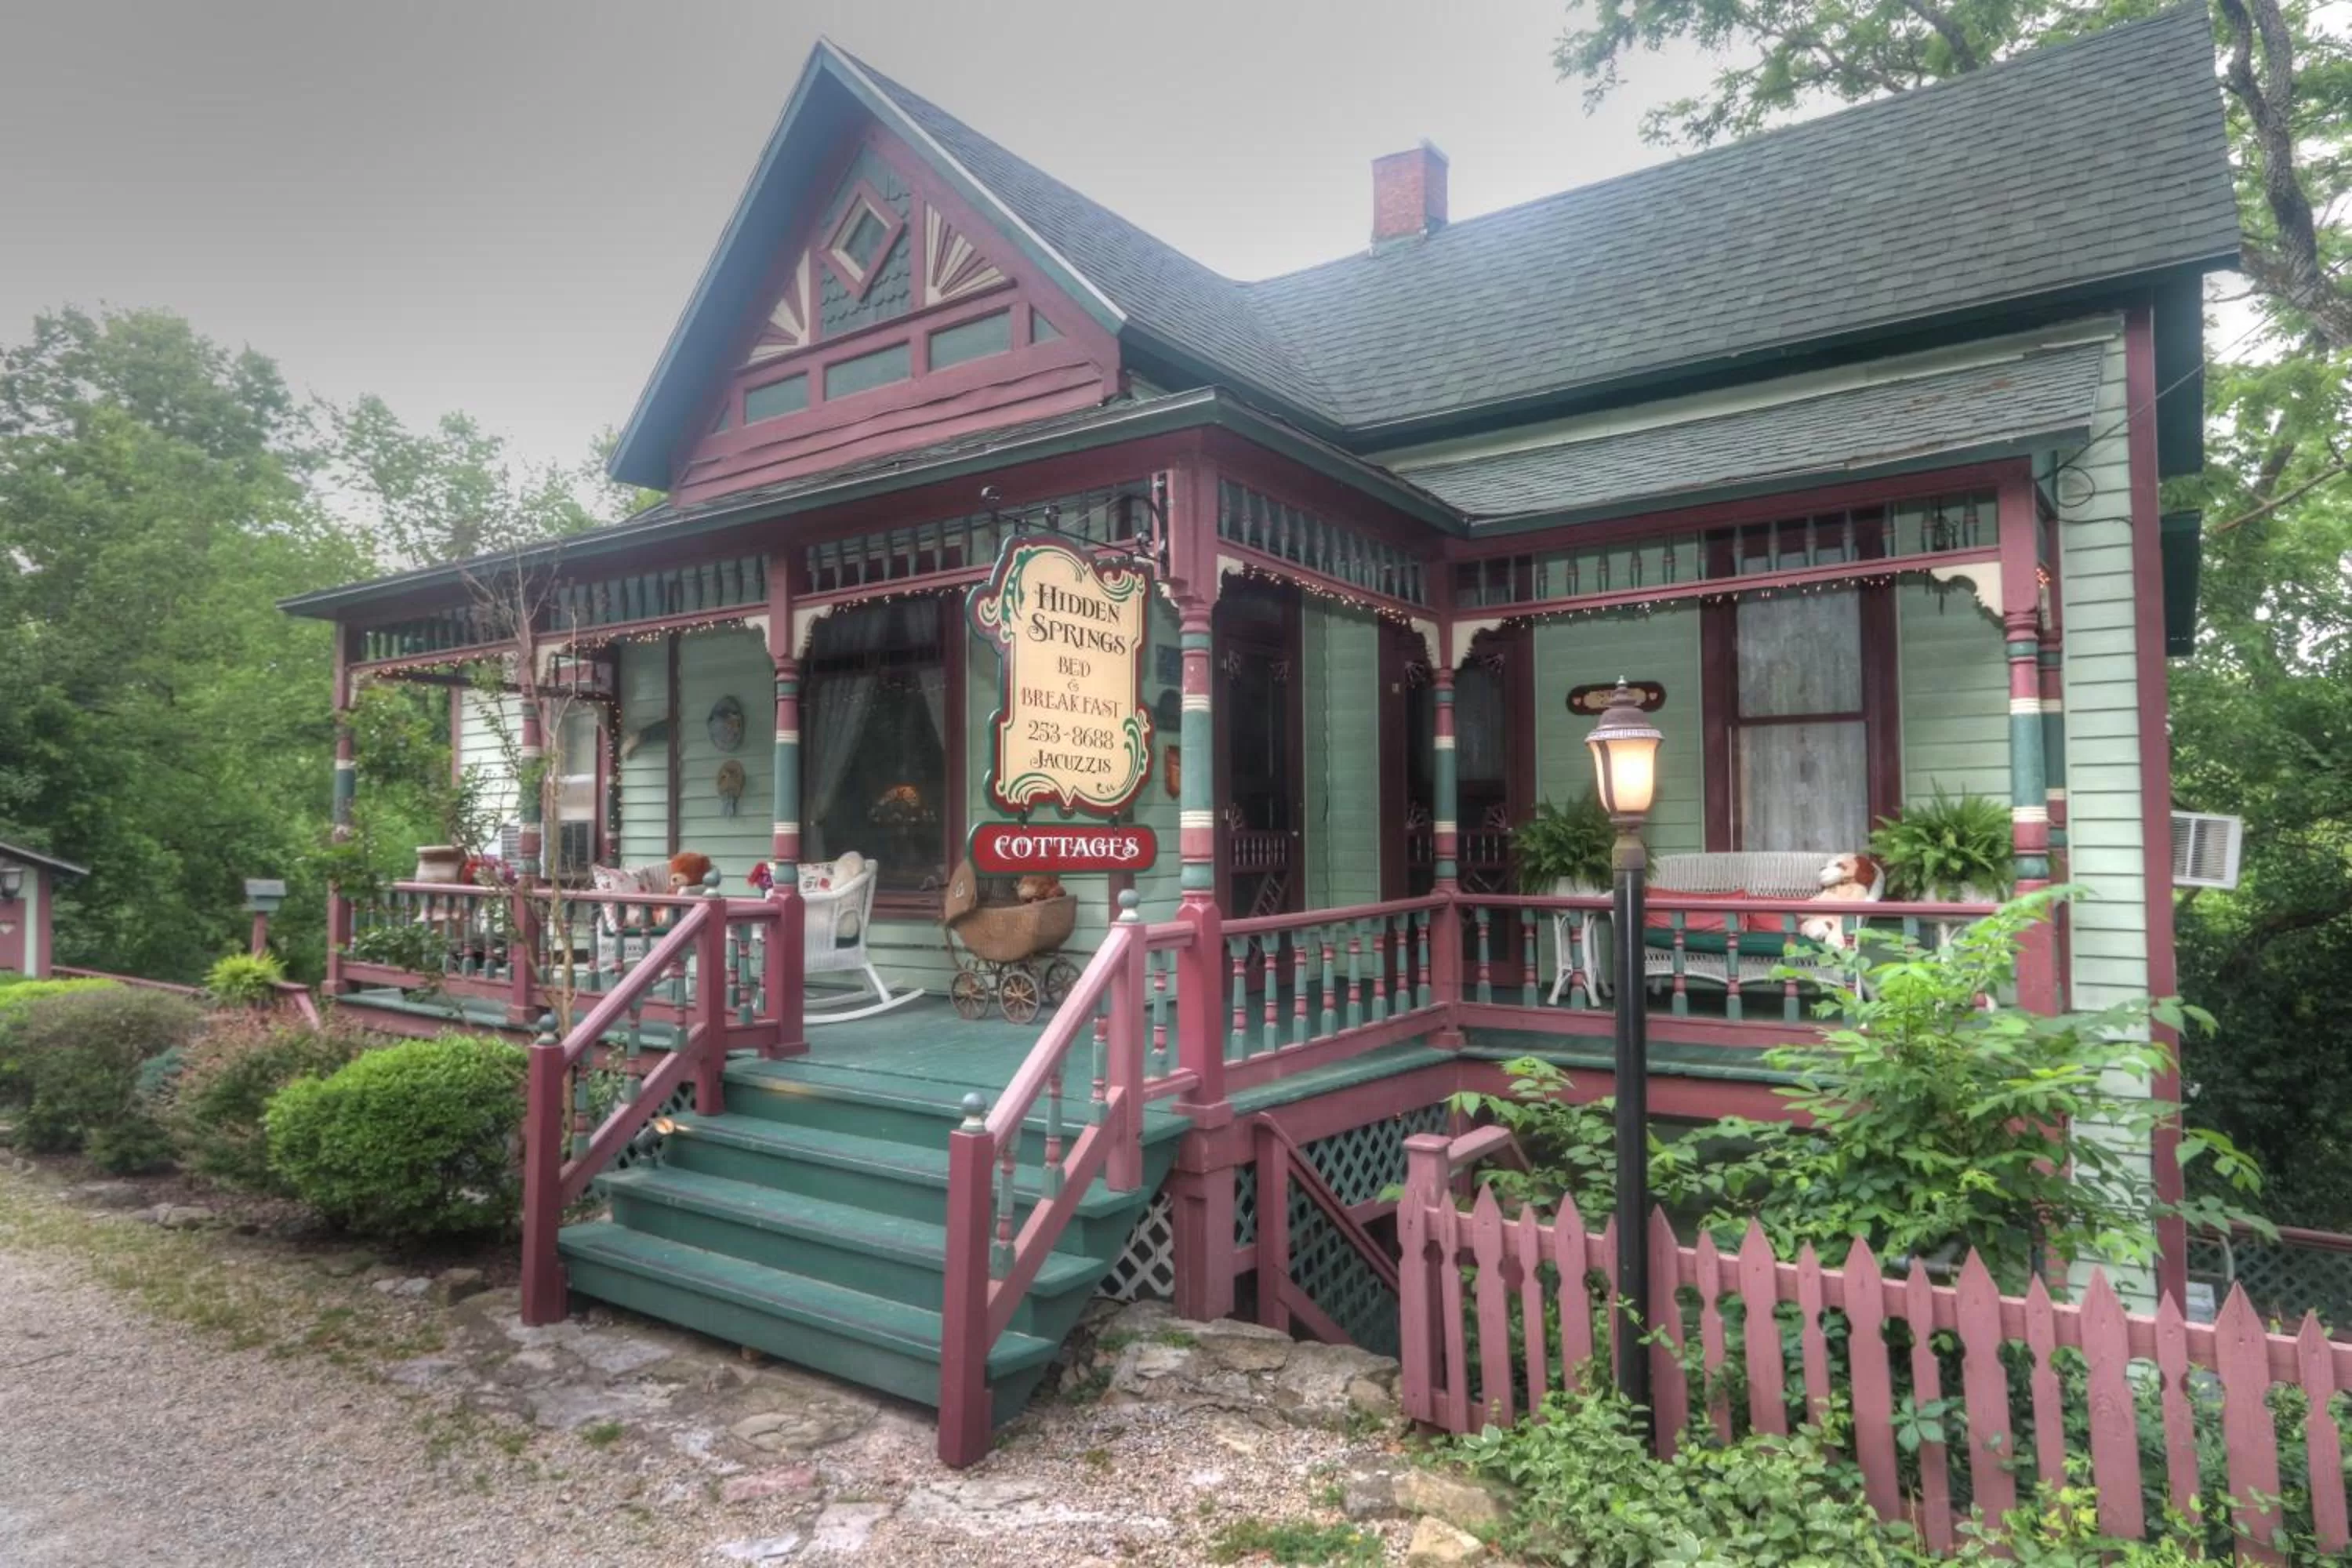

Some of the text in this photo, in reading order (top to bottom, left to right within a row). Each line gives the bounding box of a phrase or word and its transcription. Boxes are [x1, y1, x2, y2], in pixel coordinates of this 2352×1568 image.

[1035, 583, 1120, 624] HIDDEN
[1027, 612, 1126, 655] SPRINGS
[1058, 655, 1091, 678] BED
[1067, 678, 1080, 692] &
[1021, 686, 1123, 718] BREAKFAST
[1028, 719, 1114, 750] 253-8688
[1029, 749, 1112, 774] JACUZZIS
[994, 835, 1139, 861] COTTAGES
